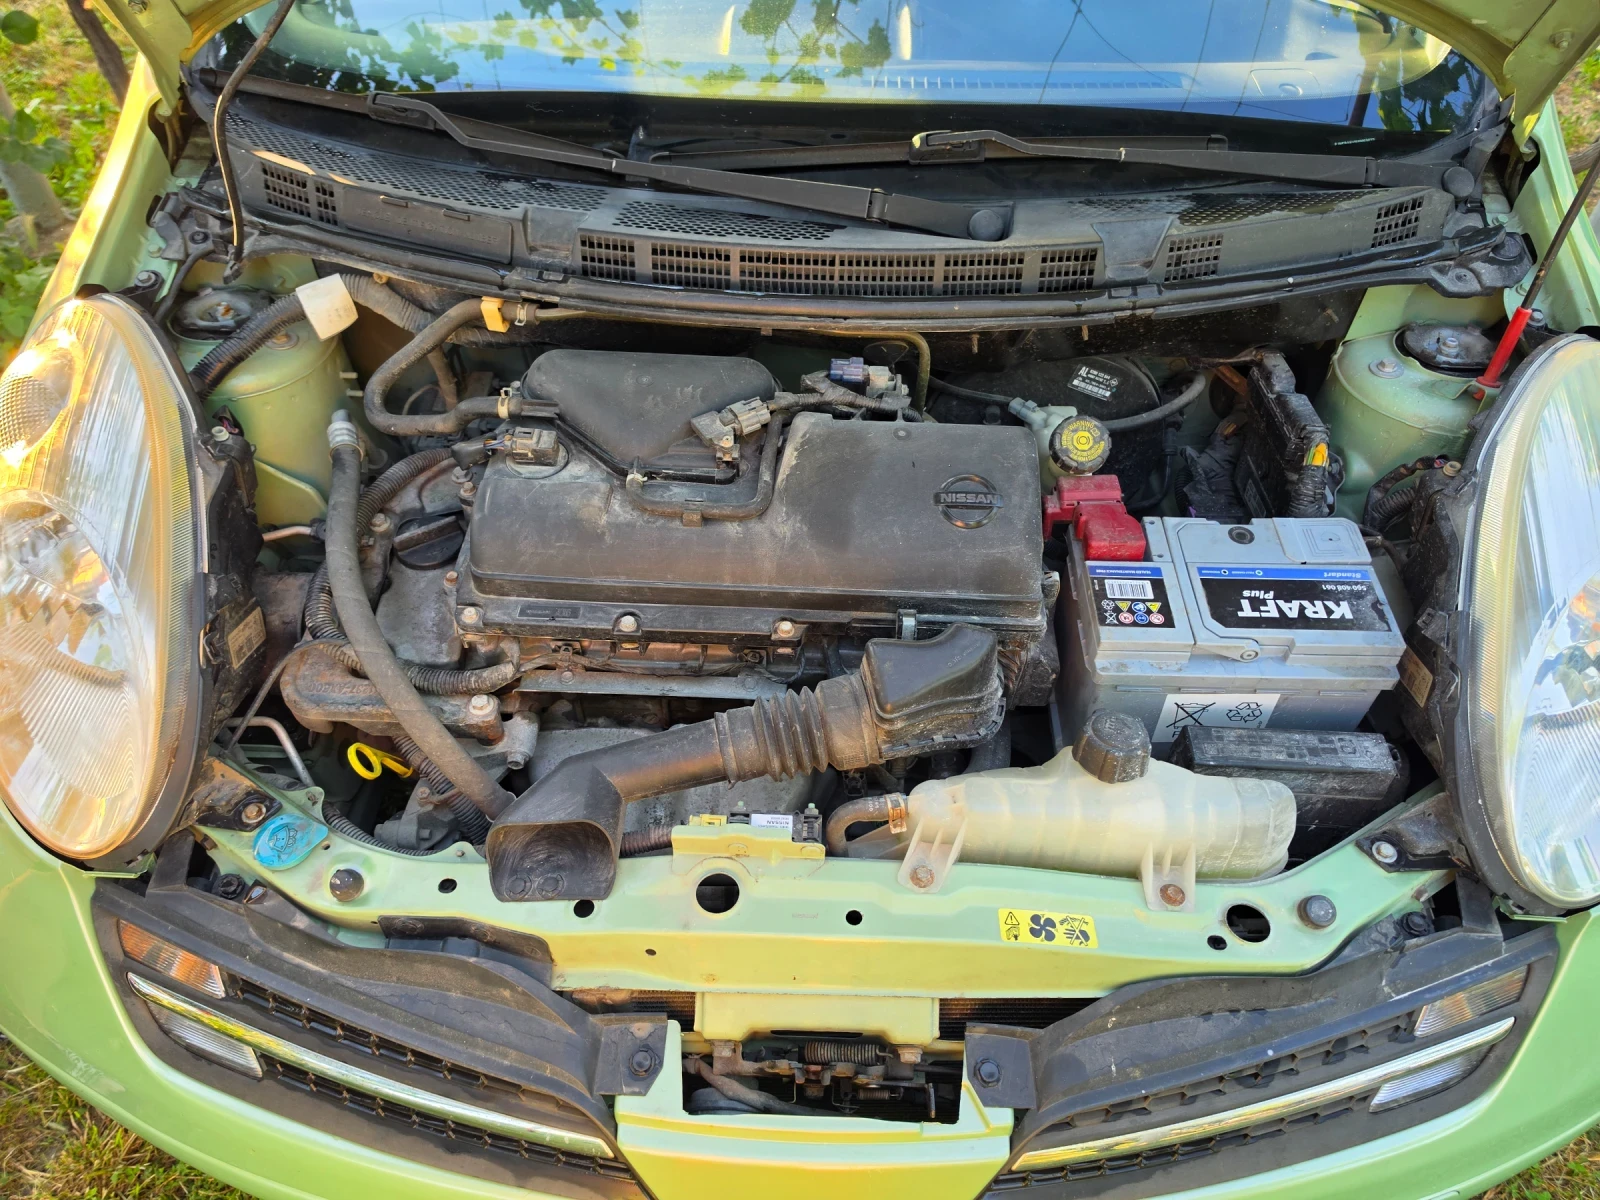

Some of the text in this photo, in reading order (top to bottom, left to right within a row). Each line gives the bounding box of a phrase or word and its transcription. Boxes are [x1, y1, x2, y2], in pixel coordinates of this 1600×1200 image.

[1078, 366, 1089, 378] AL
[1067, 420, 1095, 430] WARNING
[940, 493, 999, 504] NISSAN
[1242, 590, 1274, 600] Plus
[1237, 599, 1354, 619] KRAFT
